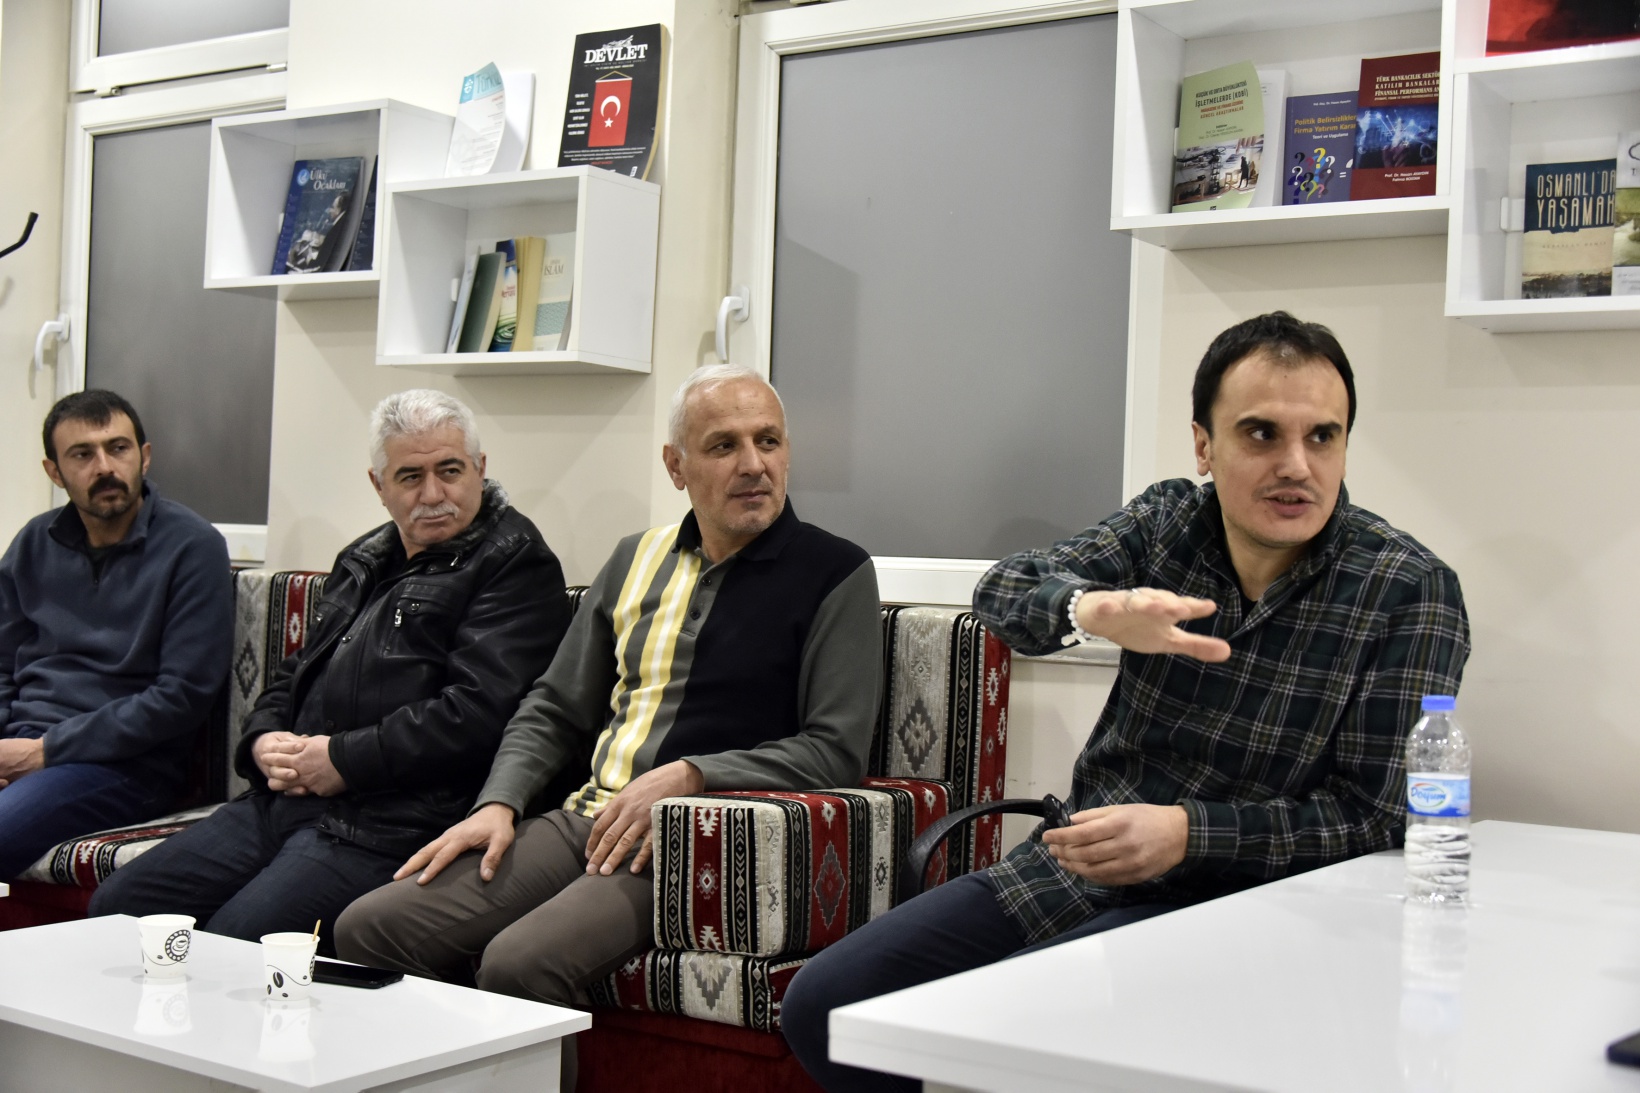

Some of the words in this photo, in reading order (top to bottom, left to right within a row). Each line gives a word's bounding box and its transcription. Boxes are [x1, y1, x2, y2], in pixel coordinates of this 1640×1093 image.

[584, 44, 648, 64] DEVLET
[1390, 73, 1421, 82] BANKACILIK
[1375, 82, 1403, 90] KATILIM
[1399, 87, 1433, 95] PERFORMANS
[1194, 93, 1232, 108] İŞLETMELERDE
[1295, 118, 1315, 126] Politik
[1537, 169, 1616, 198] OSMANLI'DA
